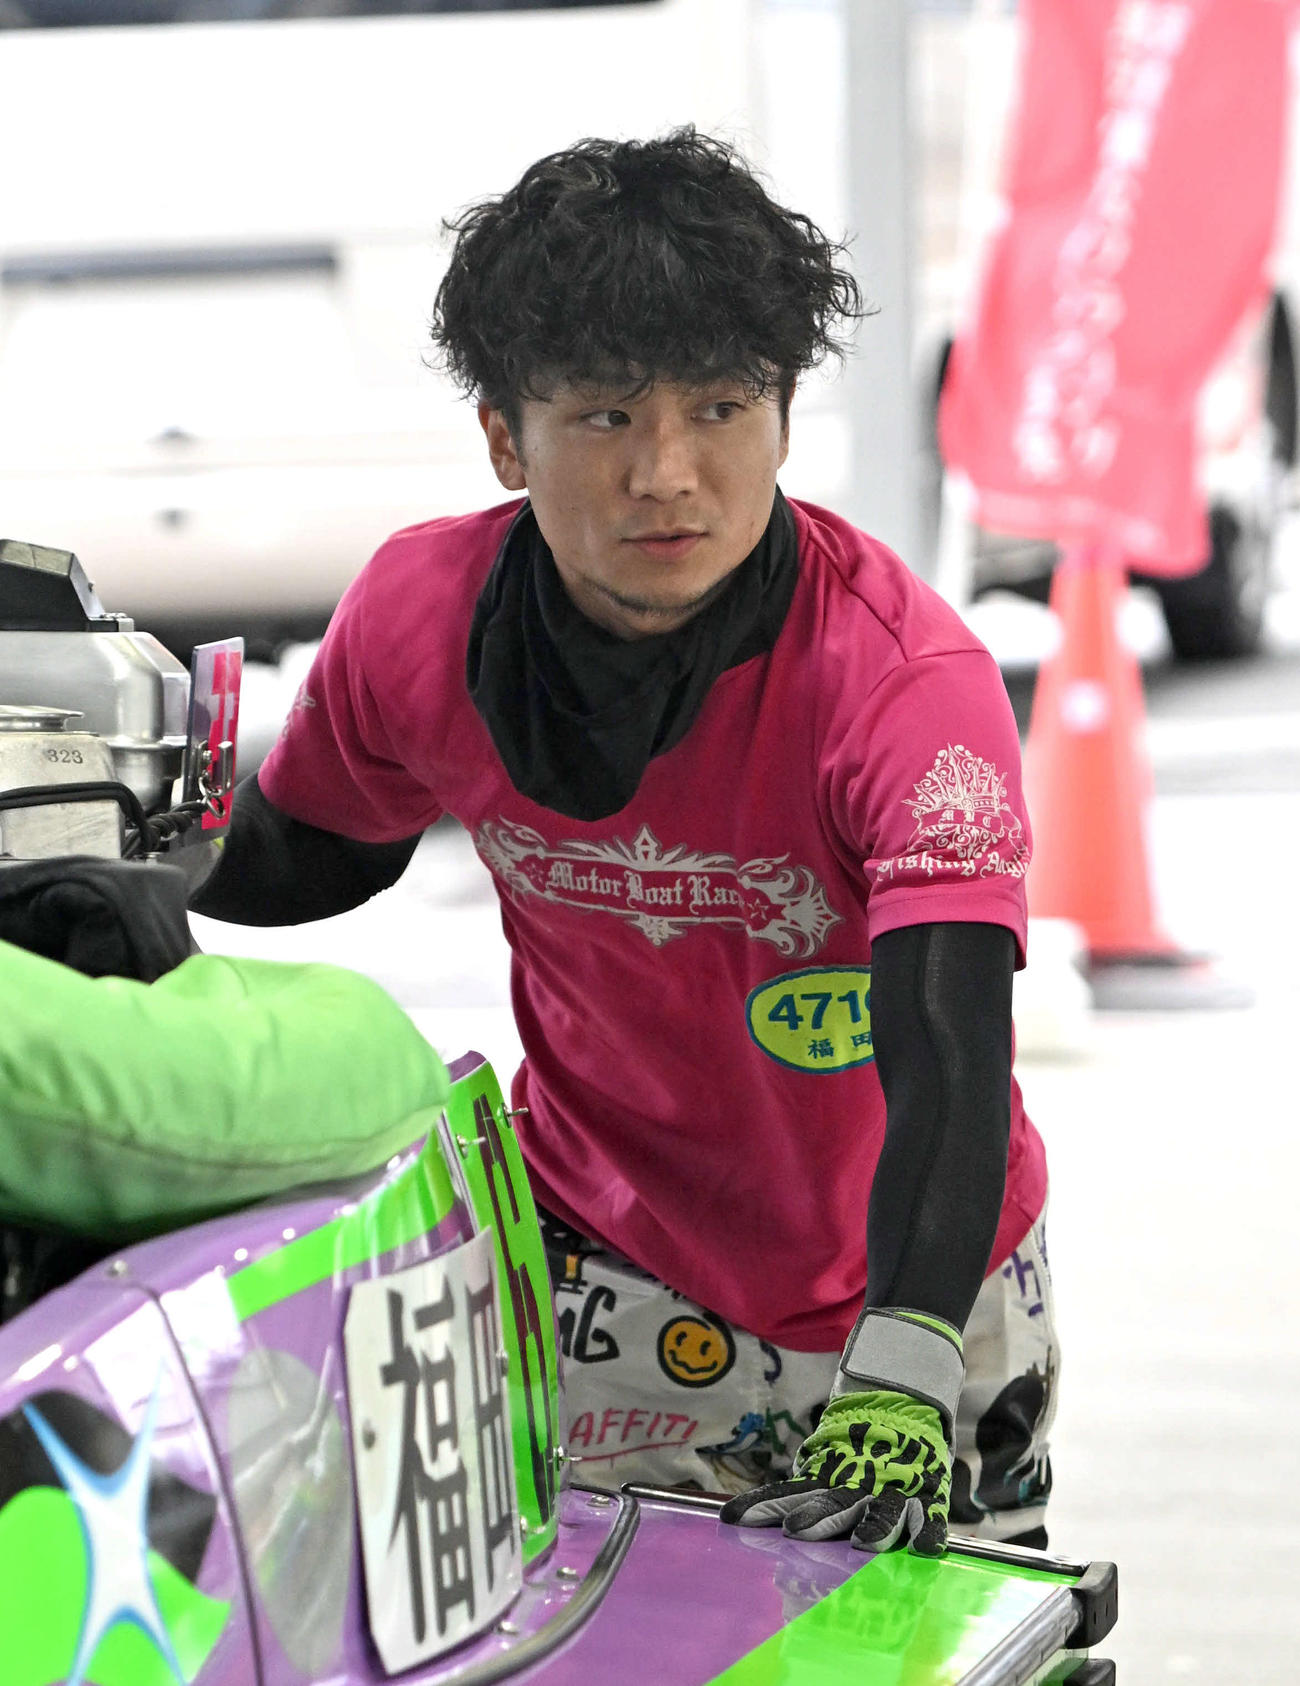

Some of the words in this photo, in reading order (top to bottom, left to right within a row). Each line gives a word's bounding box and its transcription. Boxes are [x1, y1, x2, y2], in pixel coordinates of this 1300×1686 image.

[47, 749, 84, 764] 323
[546, 860, 623, 897] Motor
[623, 870, 683, 909] Boat
[379, 1257, 516, 1645] 福田
